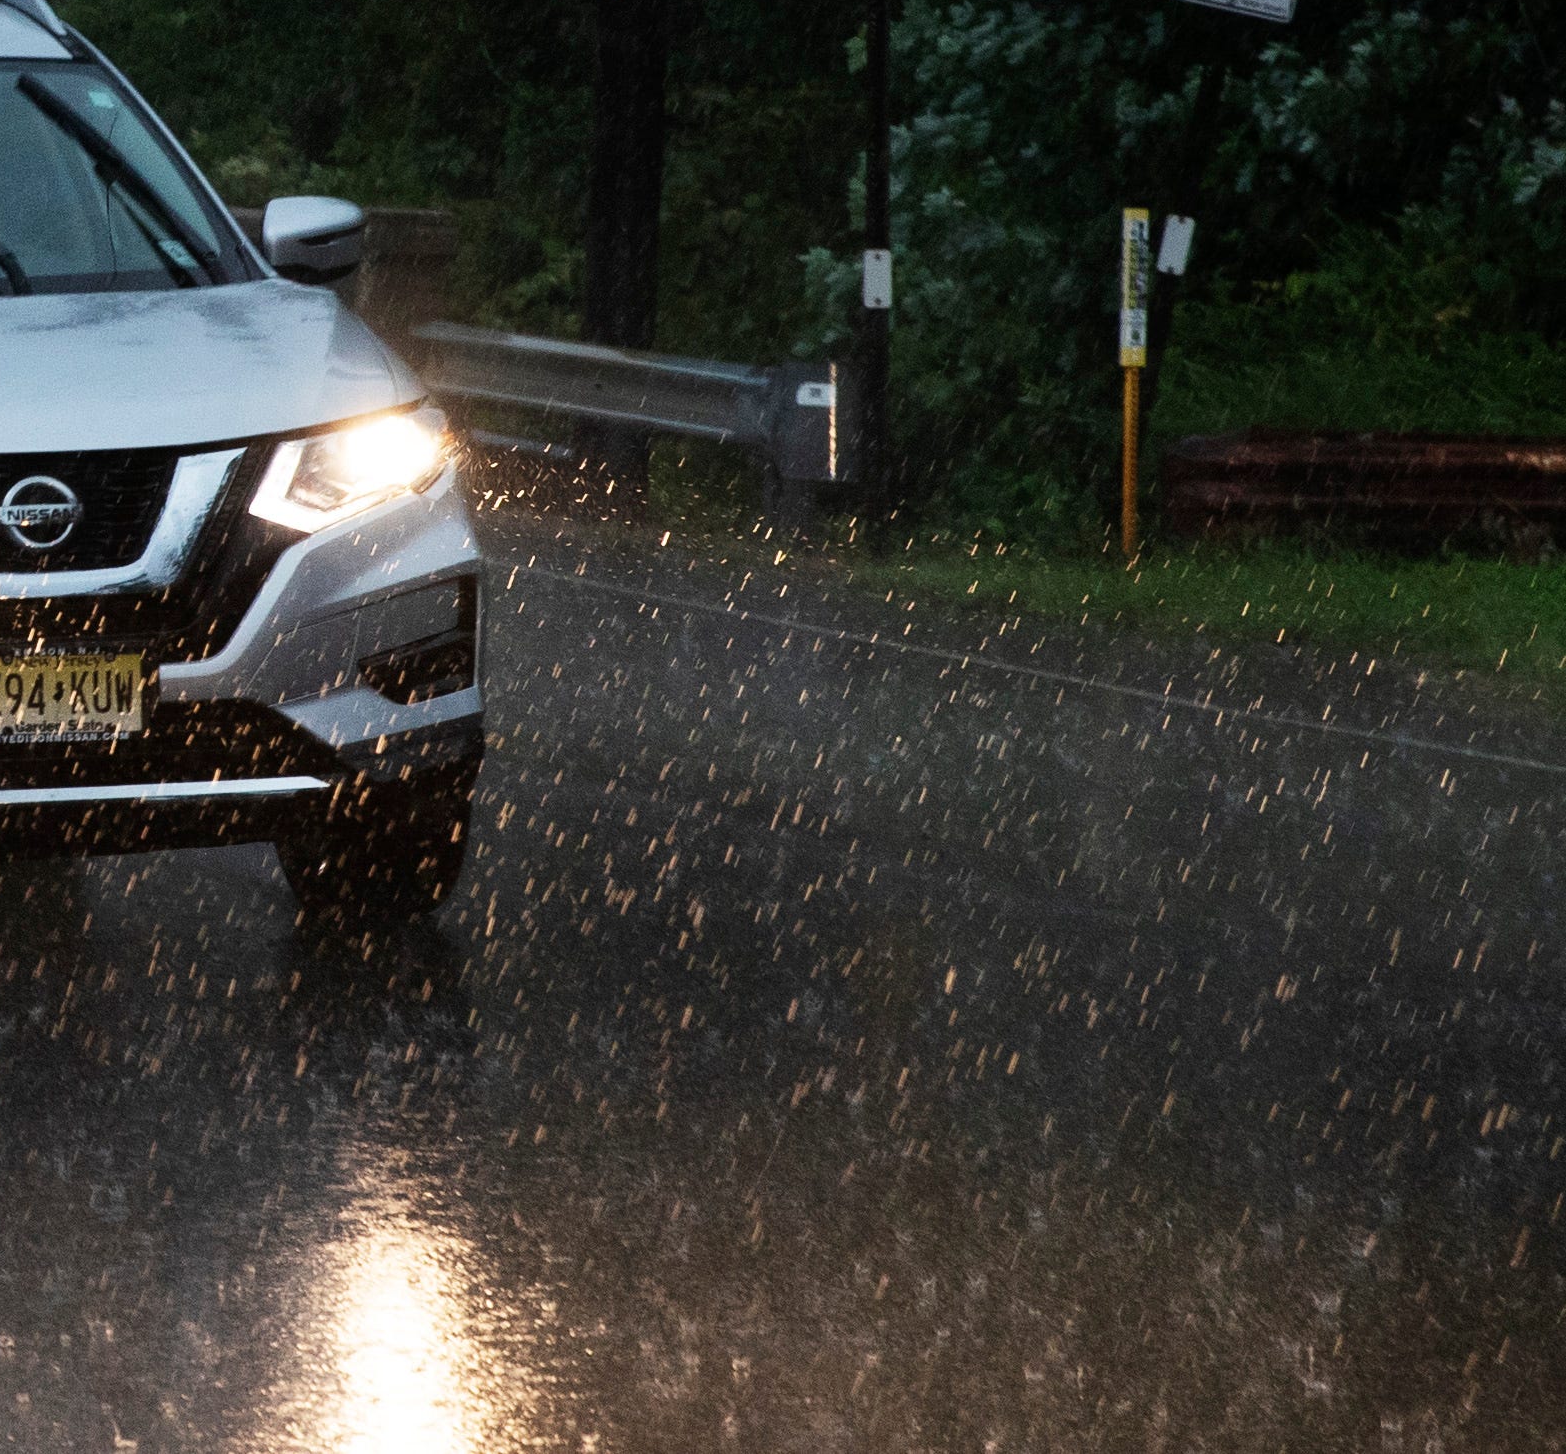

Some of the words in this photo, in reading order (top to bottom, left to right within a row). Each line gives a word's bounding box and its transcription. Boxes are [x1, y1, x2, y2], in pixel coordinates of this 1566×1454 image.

[7, 508, 76, 520] NISSAN
[16, 721, 60, 733] Garden
[67, 720, 105, 731] Sate
